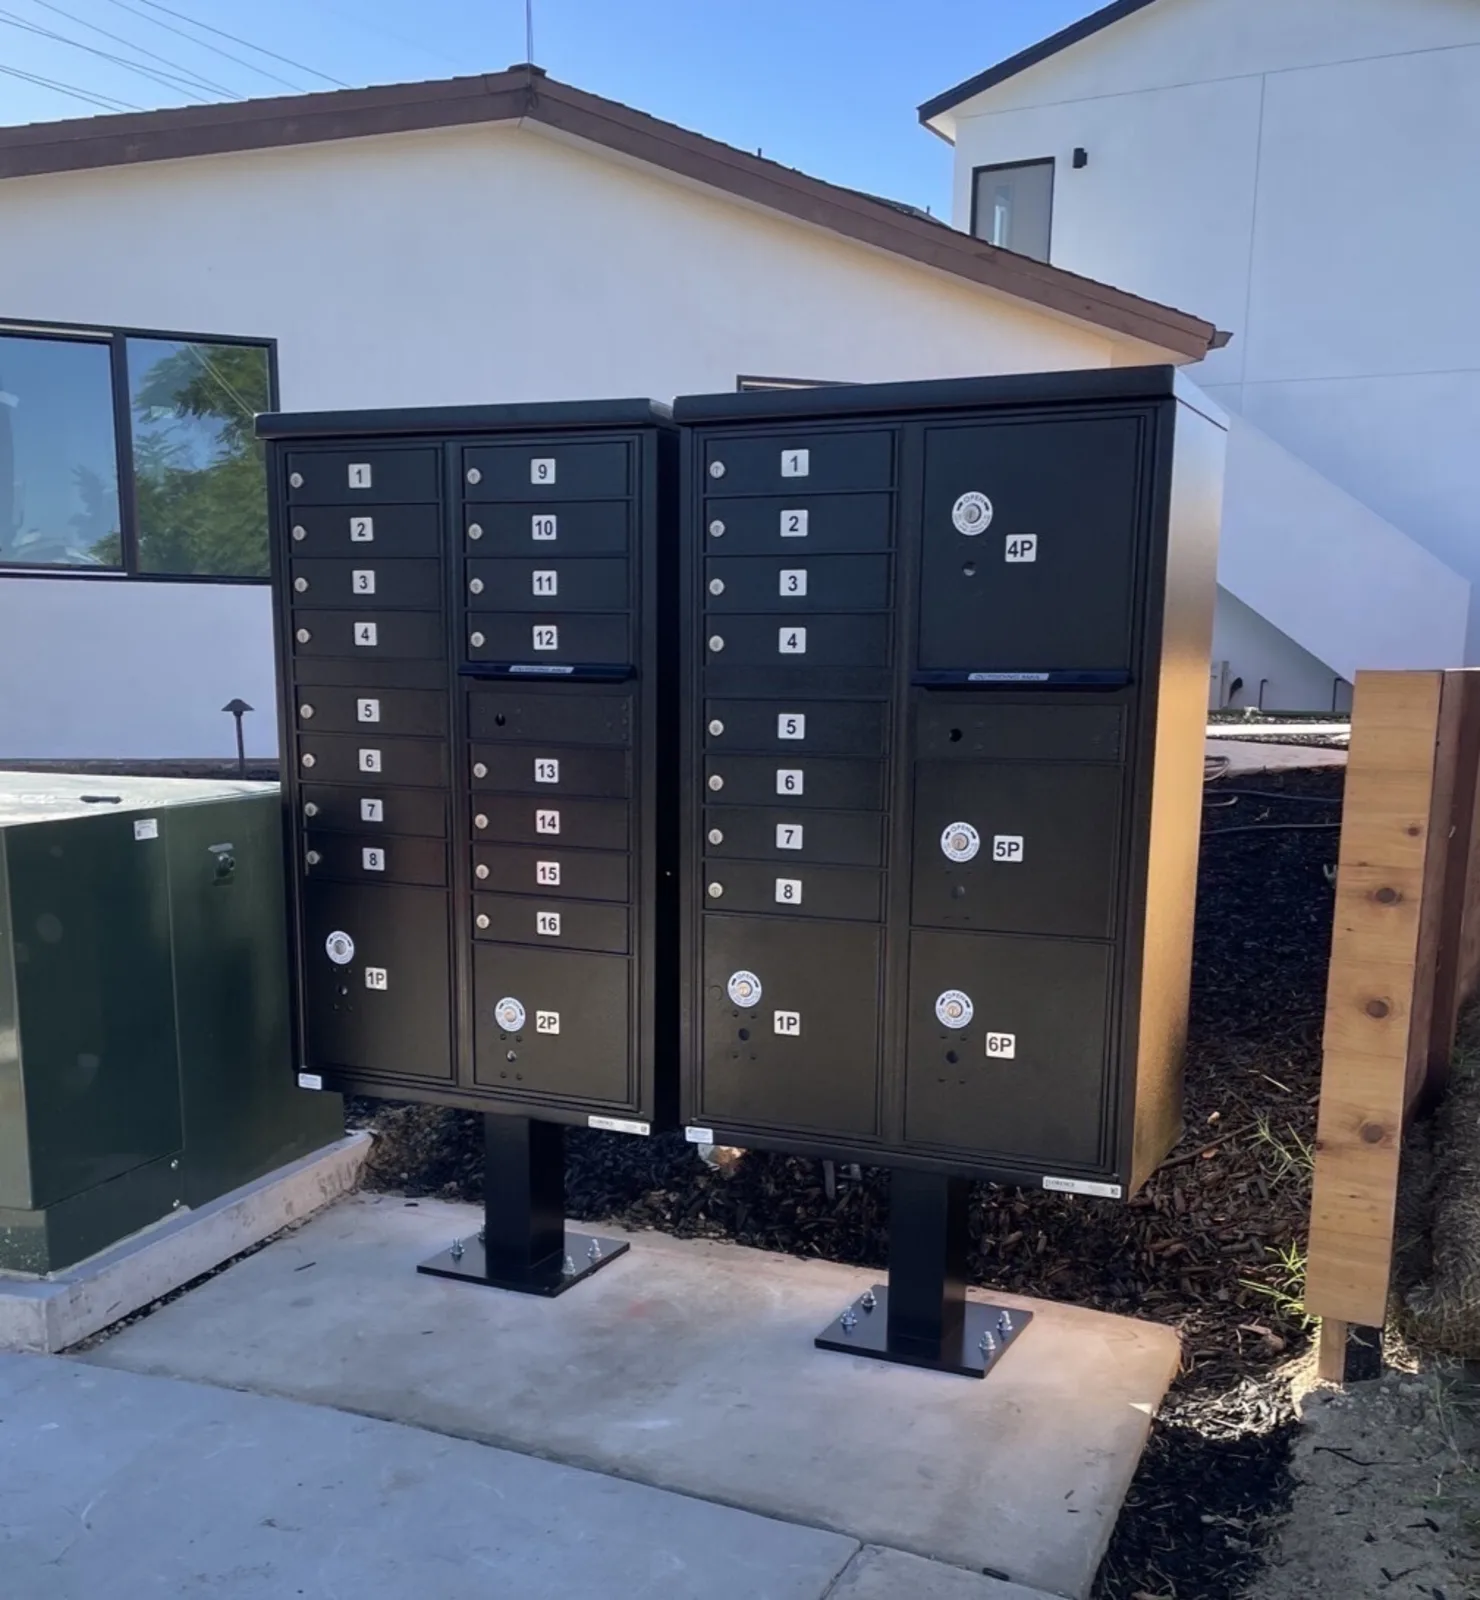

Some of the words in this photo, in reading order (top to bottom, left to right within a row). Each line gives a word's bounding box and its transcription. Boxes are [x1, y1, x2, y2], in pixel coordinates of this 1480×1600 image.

[791, 455, 798, 472] 1
[356, 469, 362, 483] 1
[538, 464, 548, 480] 9
[963, 494, 985, 503] OPEN
[357, 522, 366, 537] 2
[535, 520, 553, 536] 10
[788, 515, 799, 532] 2
[1007, 540, 1034, 558] 4P
[359, 575, 368, 590] 3
[536, 575, 552, 591] 11
[788, 575, 798, 592] 3
[360, 627, 370, 641] 4
[536, 630, 554, 646] 12
[787, 633, 798, 649] 4
[364, 703, 372, 718] 5
[786, 719, 797, 735] 5
[365, 754, 374, 768] 6
[538, 763, 555, 779] 13
[784, 774, 795, 790] 6
[367, 803, 376, 817] 7
[539, 815, 557, 829] 14
[951, 824, 971, 832] OPEN
[784, 829, 794, 844] 7
[995, 841, 1020, 858] 5P
[369, 852, 378, 866] 8
[539, 866, 557, 881] 15
[783, 884, 793, 900] 8
[540, 917, 557, 932] 16
[368, 971, 384, 985] 1P
[538, 1015, 557, 1030] 2P
[777, 1015, 798, 1031] 1P
[988, 1036, 1012, 1052] 6P
